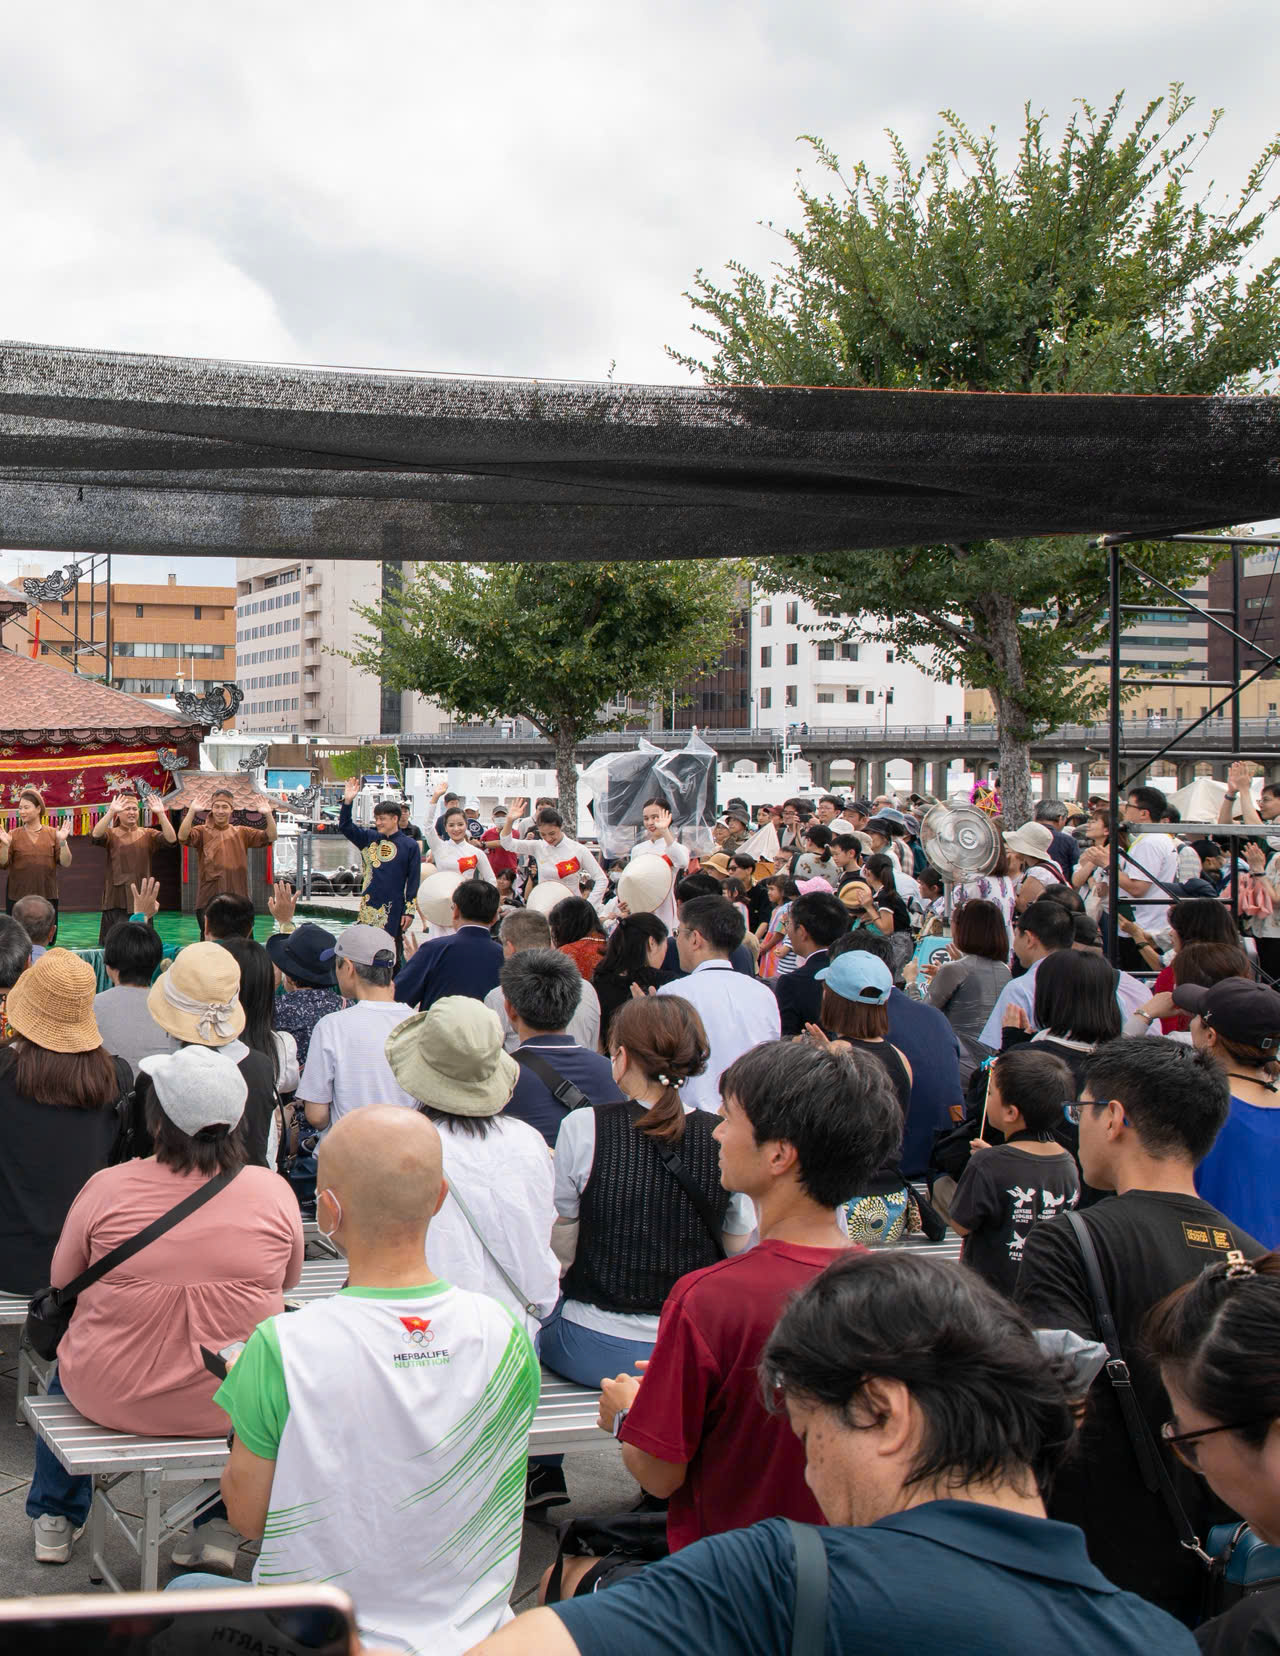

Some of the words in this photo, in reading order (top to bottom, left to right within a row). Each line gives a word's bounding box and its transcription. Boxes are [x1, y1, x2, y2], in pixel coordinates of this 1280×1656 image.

[314, 749, 352, 758] YOKOHA
[393, 1349, 449, 1361] HERBALIFE
[394, 1357, 450, 1369] NUTRITION
